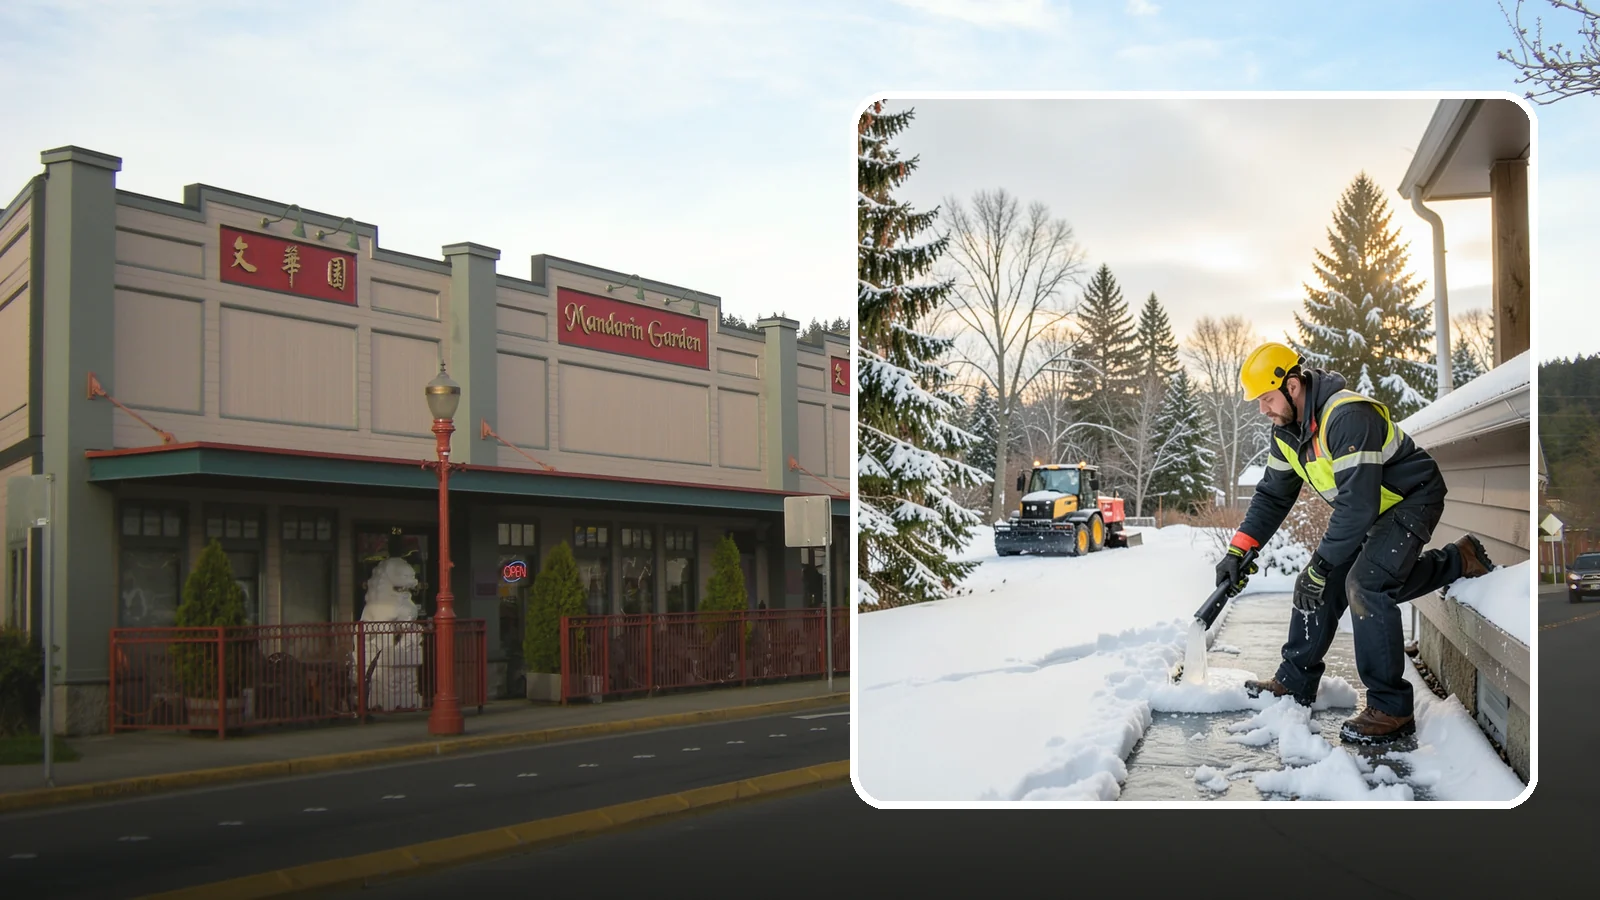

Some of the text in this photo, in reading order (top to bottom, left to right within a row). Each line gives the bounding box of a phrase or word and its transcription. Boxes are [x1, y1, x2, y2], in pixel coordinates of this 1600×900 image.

[231, 236, 346, 290] 文華園
[564, 303, 701, 352] Mandarin Garden
[835, 363, 845, 386] 文
[503, 565, 526, 578] OPEN
